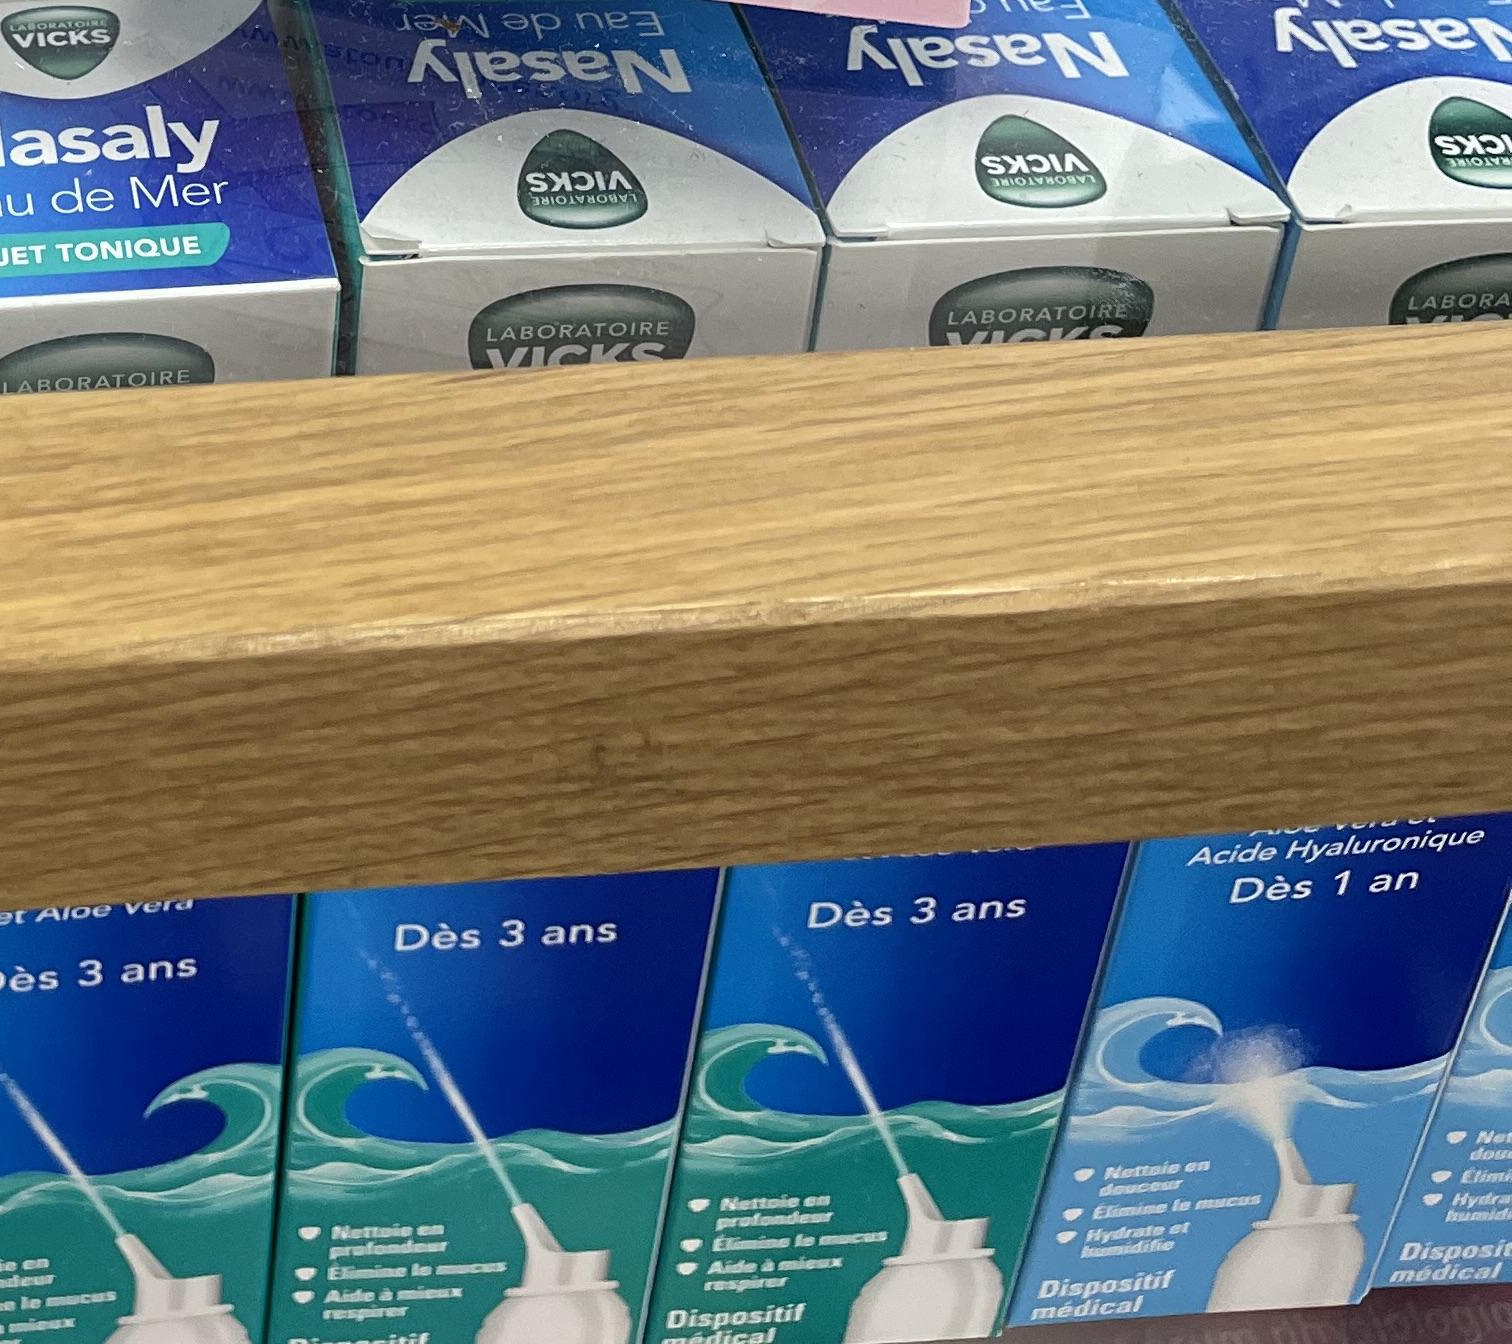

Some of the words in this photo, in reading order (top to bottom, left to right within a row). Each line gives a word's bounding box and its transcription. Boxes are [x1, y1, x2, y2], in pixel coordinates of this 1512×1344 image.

[11, 29, 111, 49] VICKS
[408, 39, 692, 100] Nasaly
[846, 24, 1130, 88] Nasaly
[982, 152, 1089, 175] VICKS
[51, 176, 116, 212] de
[130, 175, 229, 210] Mer
[526, 170, 633, 192] VICKS
[991, 173, 1096, 188] LABORATOIRE
[531, 192, 637, 208] LABORATOIRE
[63, 234, 202, 262] TONIQUE
[946, 303, 1129, 326] LABORATOIRE
[486, 319, 670, 343] LABORATOIRE
[1, 368, 192, 395] LABORATOIRE
[1186, 841, 1278, 867] Acide
[1285, 828, 1486, 863] Hyaluronique
[1228, 874, 1314, 905] Dès
[1334, 869, 1352, 897] 1
[1368, 869, 1420, 893] an
[806, 897, 894, 930] Dès
[909, 896, 937, 925] 3
[951, 896, 1028, 922] ans
[393, 919, 482, 953] Dès
[498, 918, 526, 949] 3
[541, 920, 618, 947] ans
[77, 959, 103, 989] 3
[120, 956, 199, 985] ans
[1037, 1269, 1177, 1300] Dispositif
[1389, 1261, 1504, 1284] médical
[665, 1302, 808, 1330] Dispositif
[1030, 1295, 1145, 1321] médical
